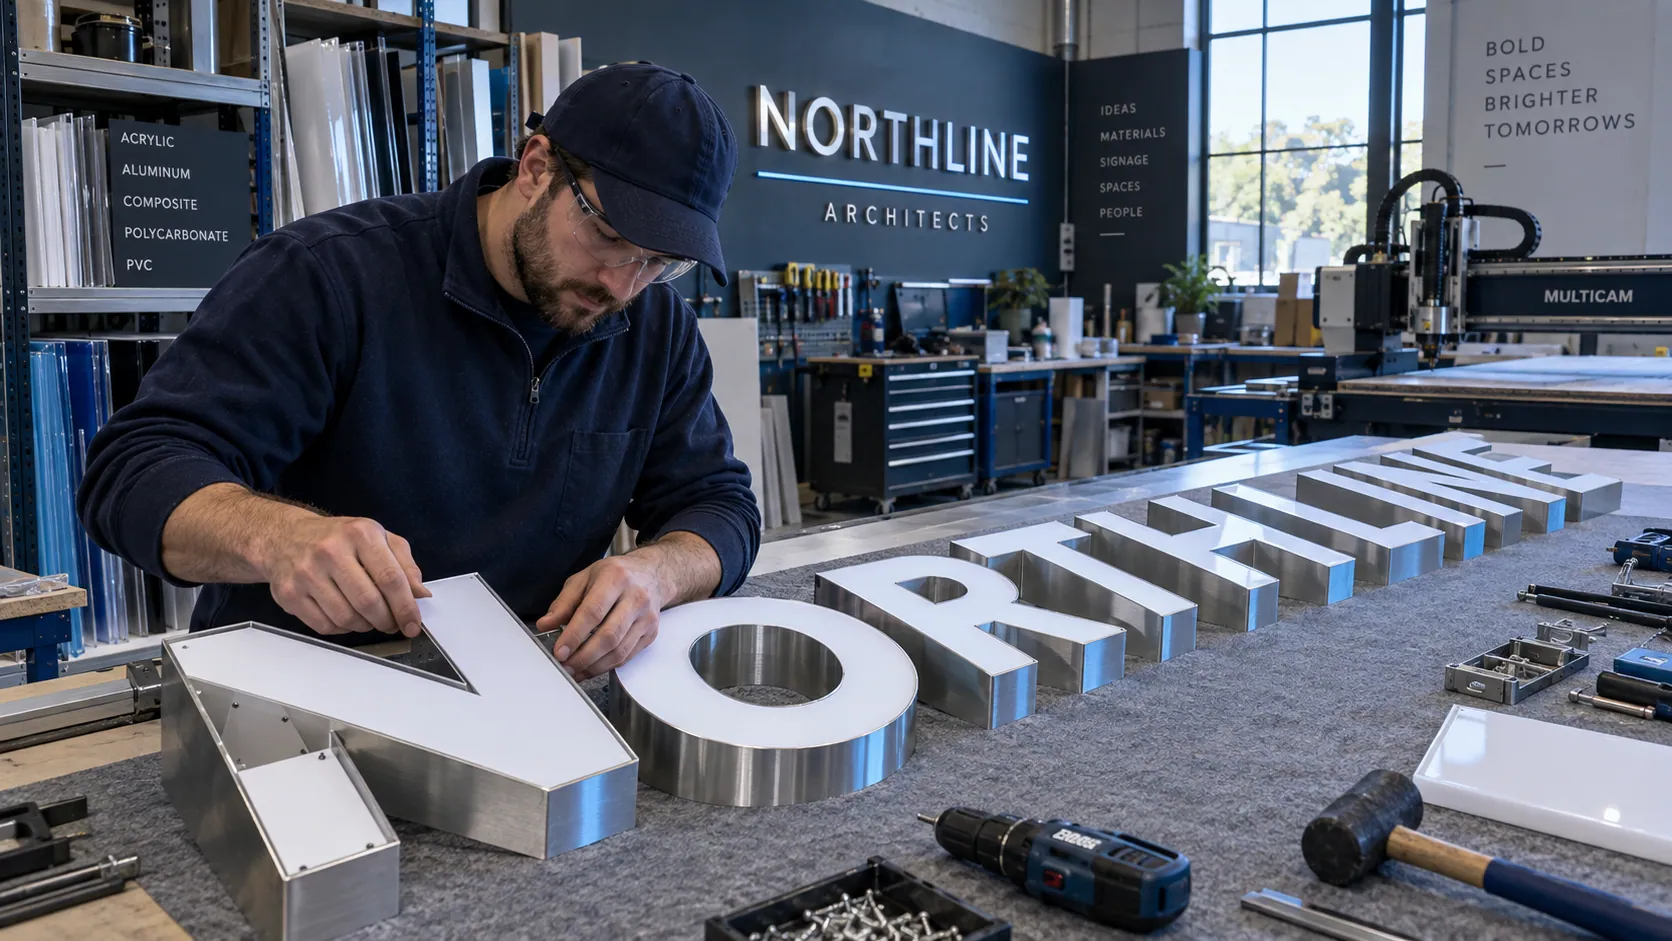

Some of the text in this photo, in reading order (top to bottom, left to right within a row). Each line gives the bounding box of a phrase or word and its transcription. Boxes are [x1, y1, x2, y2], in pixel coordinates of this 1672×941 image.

[1486, 36, 1545, 57] BOLD
[1485, 61, 1571, 85] SPACES
[1485, 87, 1598, 112] BRIGHTER
[1100, 102, 1137, 116] IDEAS
[756, 84, 1030, 182] NORTHLINE
[1100, 126, 1166, 142] MATERIALS
[1484, 113, 1636, 139] TOMORROWS
[120, 131, 175, 148] ACRYLIC
[1100, 154, 1149, 168] SIGNAGE
[121, 163, 191, 180] ALUMINUM
[1099, 180, 1141, 193] SPACES
[123, 194, 198, 211] COMPOSITE
[824, 202, 990, 232] ARCHITECTS
[1099, 206, 1143, 219] PEOPLE
[124, 226, 229, 242] POLYCARBONATE
[126, 258, 153, 271] PVC
[1543, 288, 1634, 303] MULTICAM
